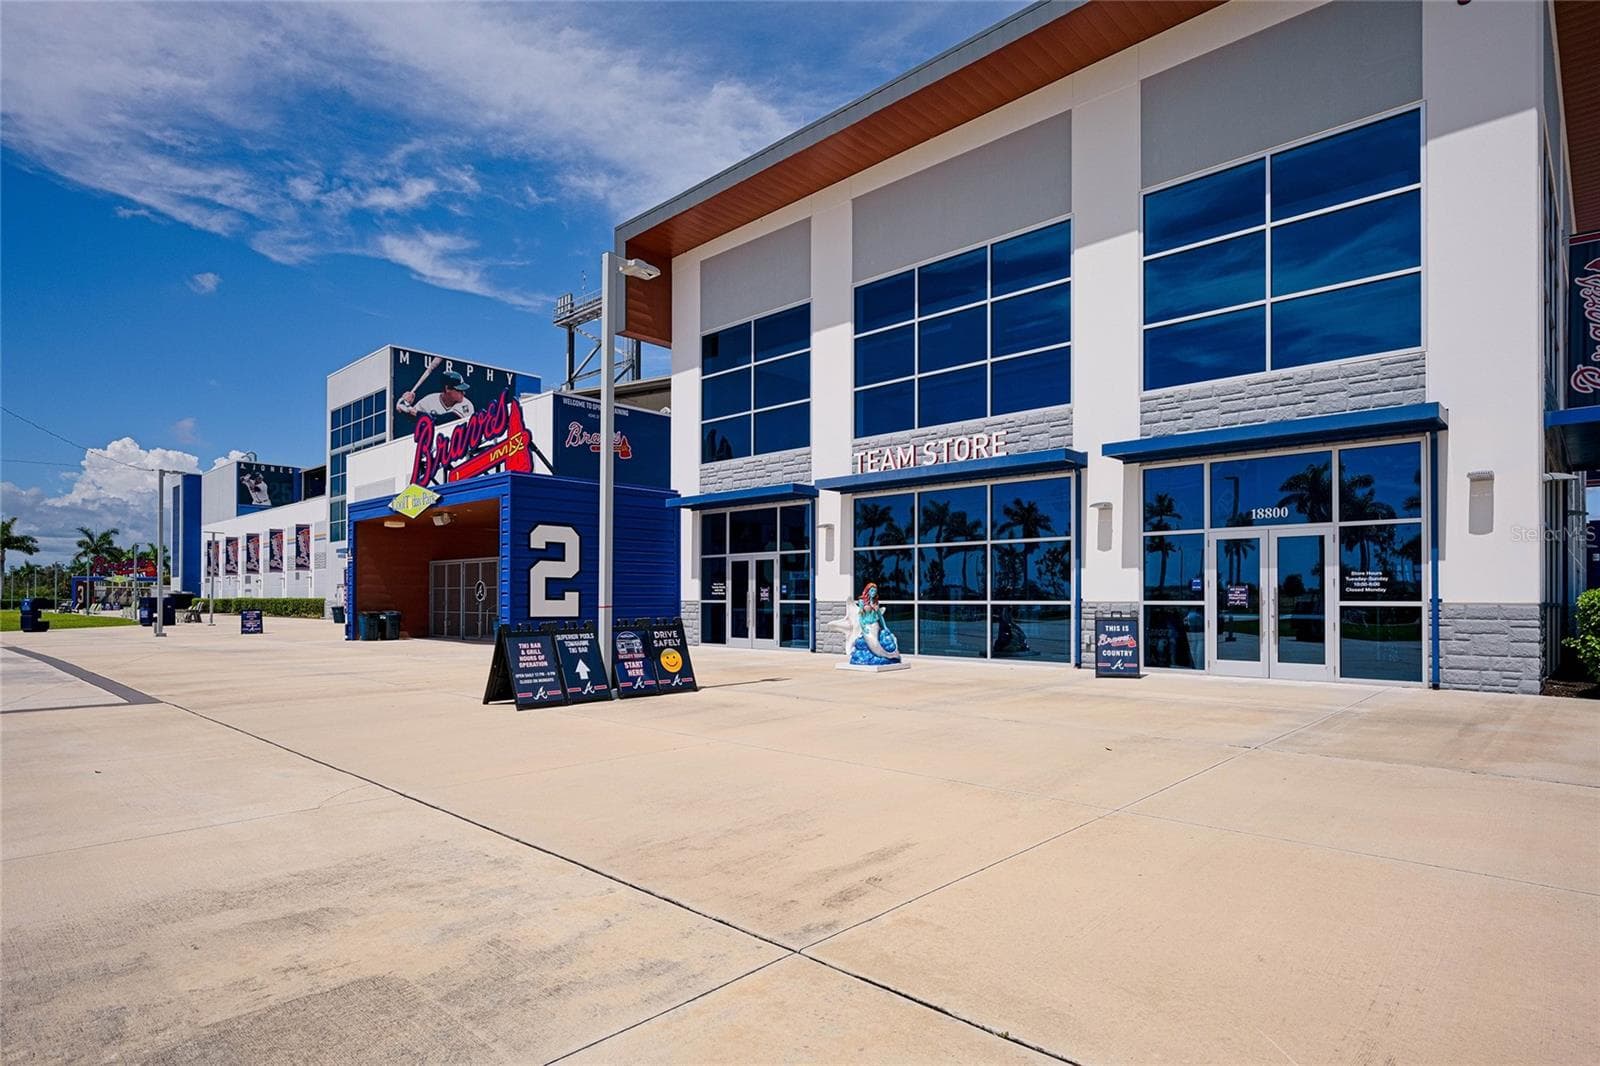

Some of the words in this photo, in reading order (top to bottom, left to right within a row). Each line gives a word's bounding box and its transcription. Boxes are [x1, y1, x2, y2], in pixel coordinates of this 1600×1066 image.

[400, 350, 514, 386] MURPHY
[563, 397, 586, 409] WELCOME
[411, 387, 509, 487] Braves
[853, 444, 918, 474] TEAM
[923, 430, 1008, 466] STORE
[1251, 506, 1289, 520] 18800
[530, 524, 580, 618] 2
[77, 585, 84, 604] 3
[653, 630, 678, 639] DRIVE
[1097, 633, 1131, 647] Braves
[653, 638, 680, 647] SAFELY
[519, 661, 548, 669] OPERATION
[624, 661, 643, 669] START
[627, 668, 644, 677] HERE
